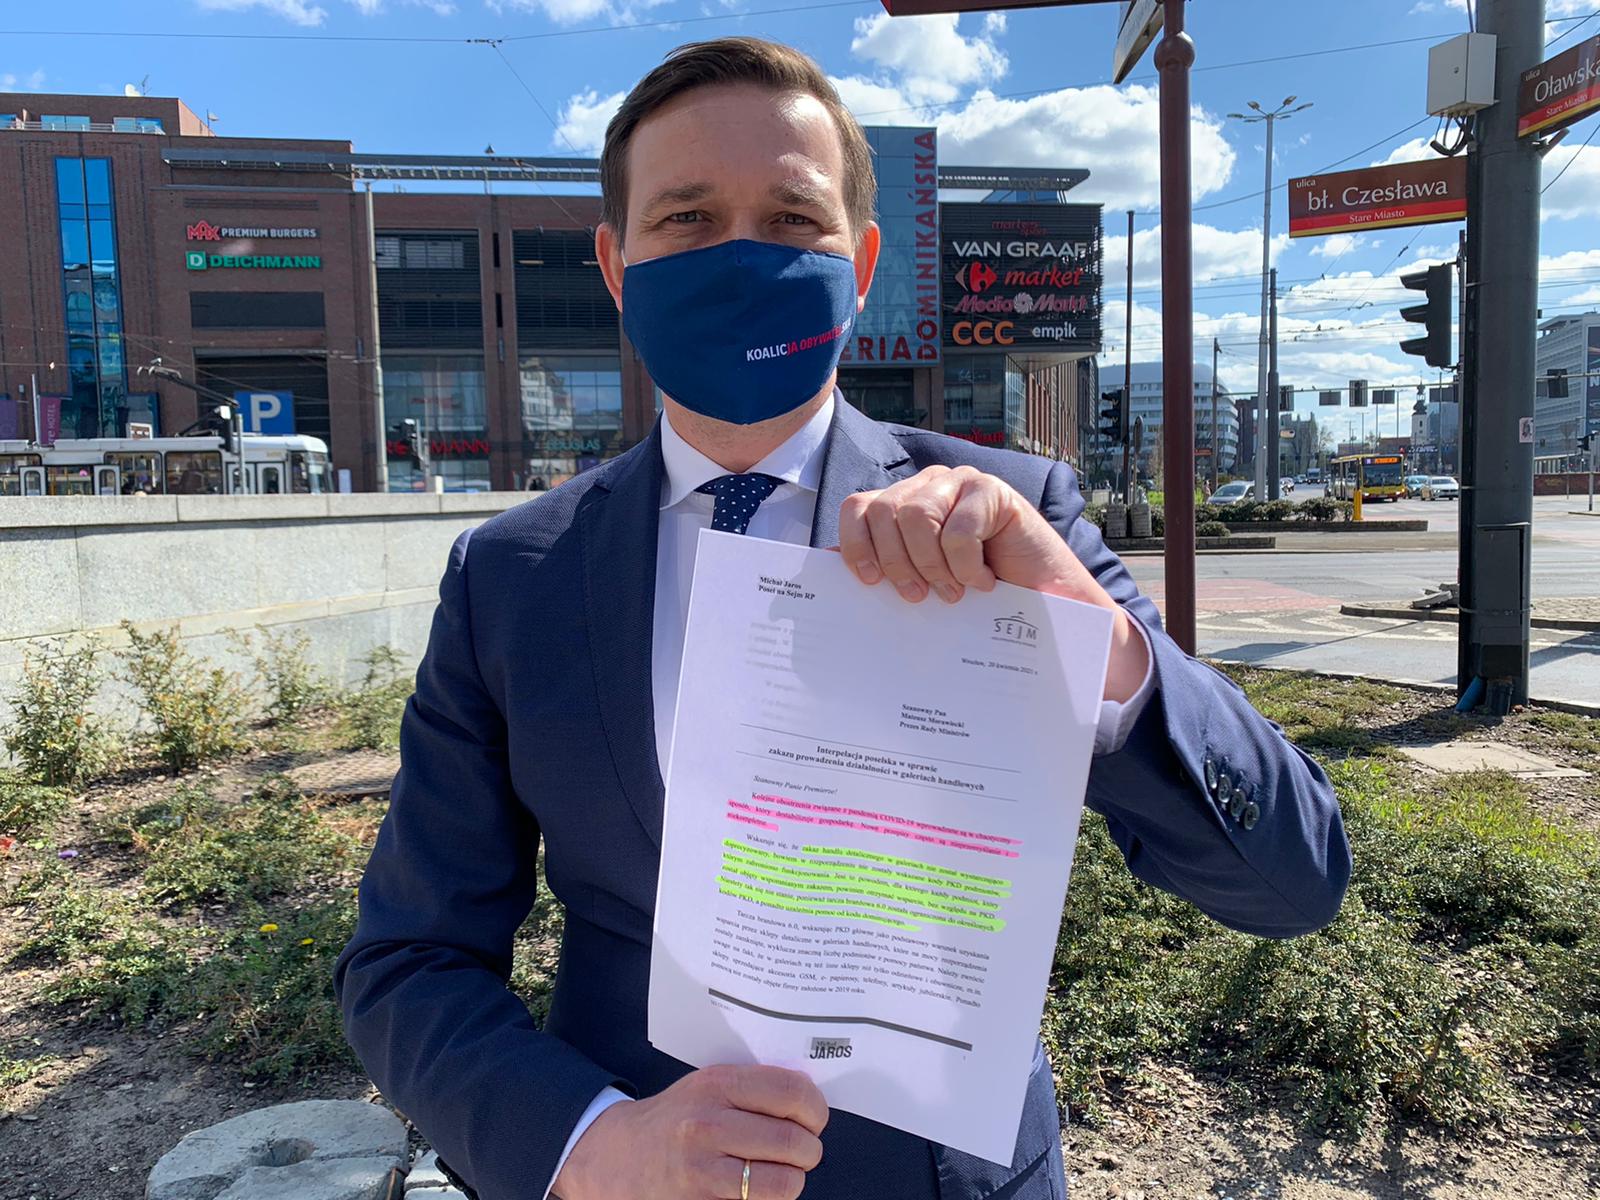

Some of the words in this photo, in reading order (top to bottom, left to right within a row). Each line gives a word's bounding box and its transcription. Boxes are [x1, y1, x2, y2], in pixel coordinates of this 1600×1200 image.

[1546, 104, 1563, 117] Stare
[1296, 178, 1316, 188] ulica
[1308, 190, 1334, 211] bł.
[1342, 180, 1448, 206] Czesława
[1350, 213, 1371, 223] Stare
[1374, 210, 1405, 220] Miasto
[221, 227, 268, 238] PREMIUM
[270, 228, 317, 238] BURGERS
[908, 131, 938, 360] DOMINIKAŃSKA
[952, 241, 1001, 258] VAN
[1006, 241, 1088, 258] GRAAF
[209, 254, 321, 268] DEICHMANN
[1004, 266, 1085, 289] market
[952, 320, 1015, 346] CCC
[1032, 321, 1078, 341] empik
[746, 343, 799, 361] KOALICJA
[251, 393, 281, 432] P
[817, 746, 863, 761] Interpelacja
[864, 755, 897, 767] poselska
[907, 763, 938, 773] sprawie
[768, 747, 795, 759] zakazu
[795, 753, 844, 767] prowadzenia
[846, 761, 891, 775] działalności
[900, 772, 936, 783] galeriach
[937, 776, 985, 791] handlowych
[809, 1045, 853, 1060] JAROS
